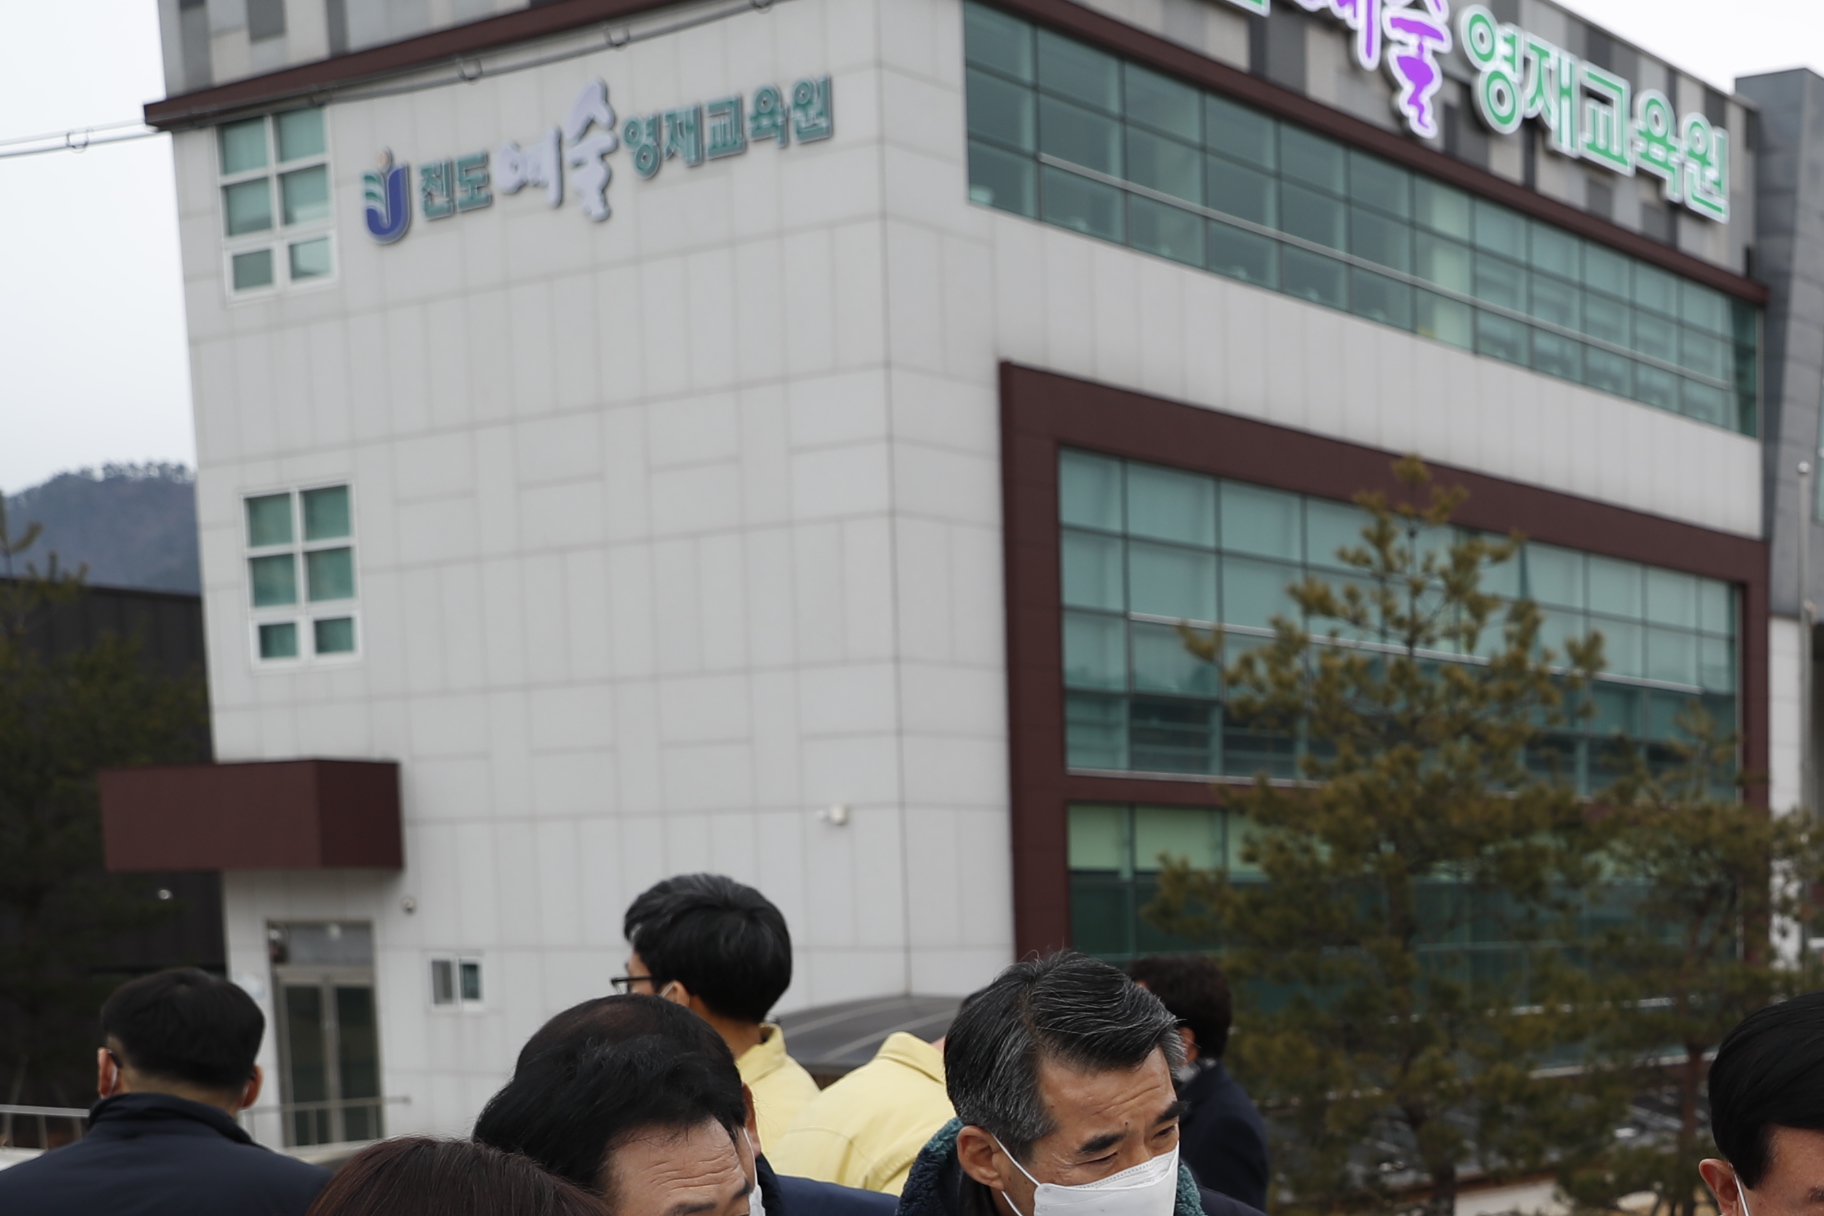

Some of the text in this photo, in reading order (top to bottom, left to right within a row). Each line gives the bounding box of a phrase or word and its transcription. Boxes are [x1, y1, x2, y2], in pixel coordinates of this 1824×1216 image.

[421, 151, 493, 220] 진도
[623, 76, 834, 179] 영재교육원
[1461, 4, 1730, 224] 영재교육원
